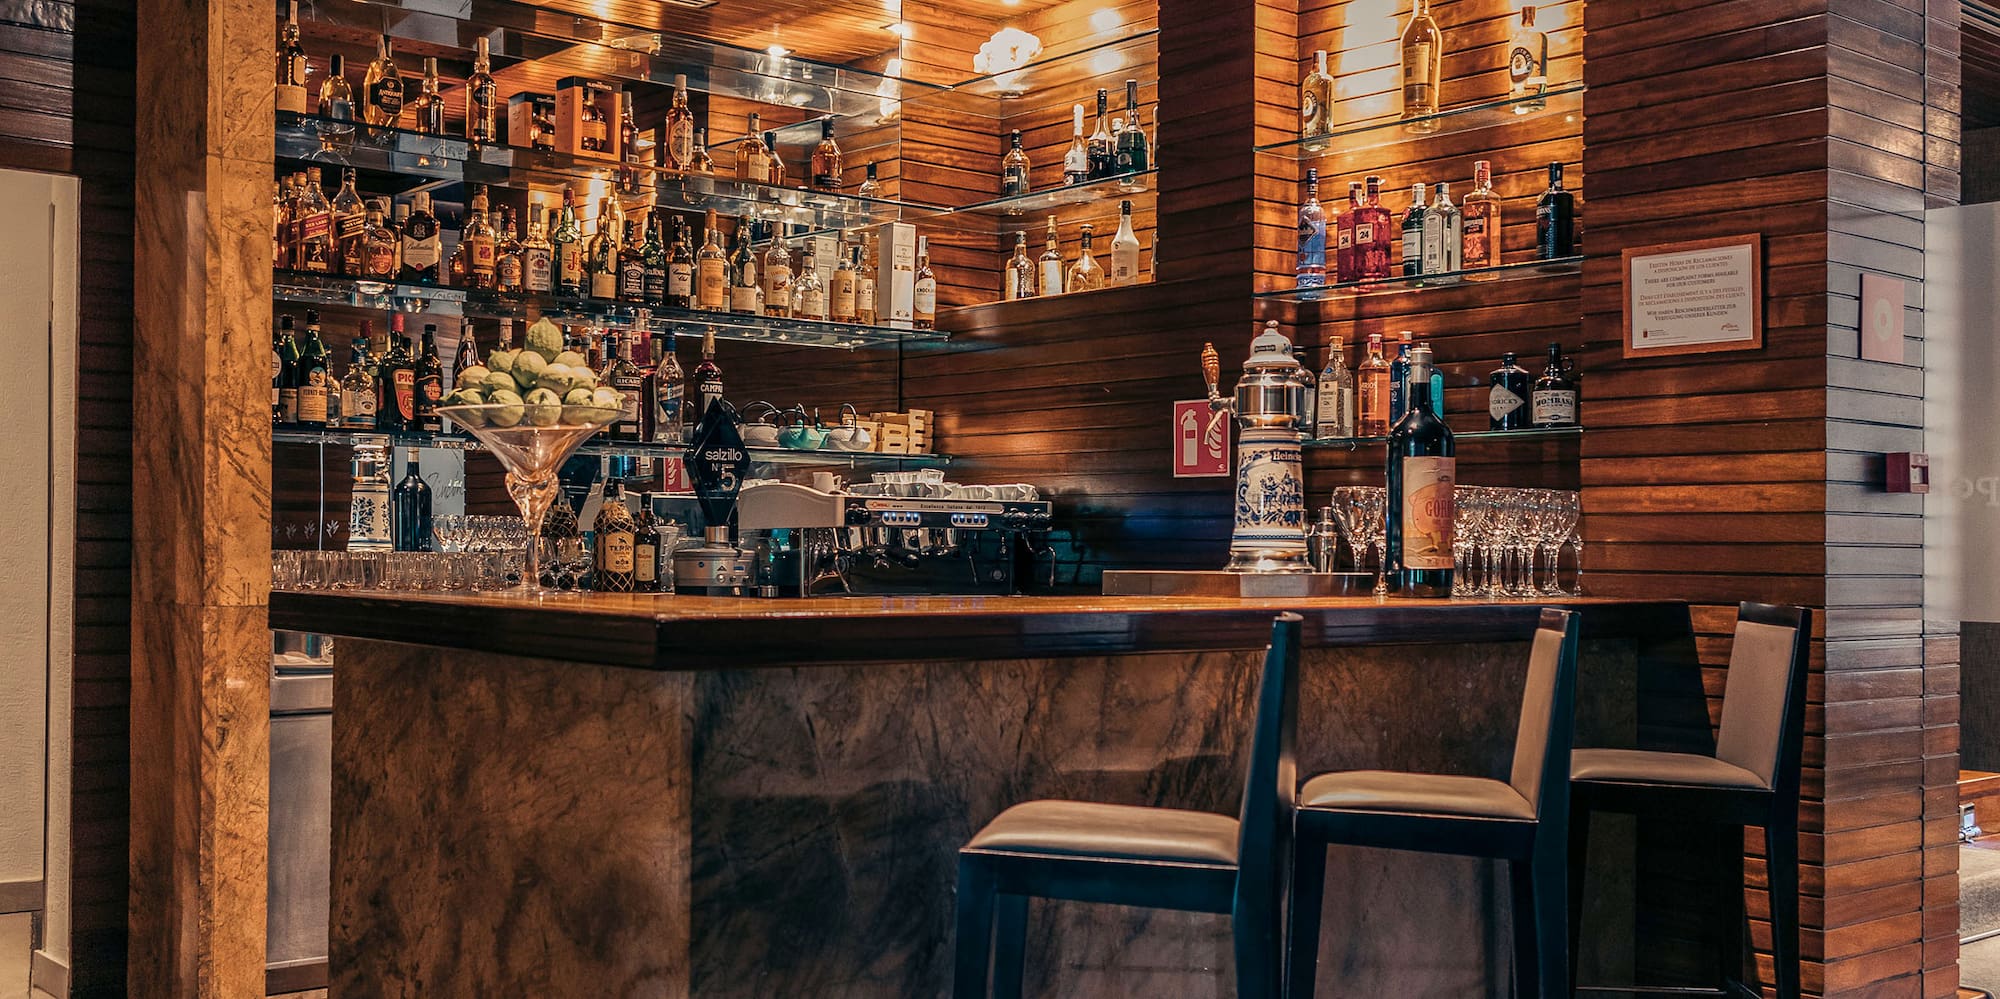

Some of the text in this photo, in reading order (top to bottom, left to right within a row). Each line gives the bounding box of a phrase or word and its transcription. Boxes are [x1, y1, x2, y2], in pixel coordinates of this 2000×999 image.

[1340, 236, 1349, 245] 24
[1359, 230, 1369, 240] 24
[704, 447, 743, 462] salzillo
[720, 463, 737, 491] 5
